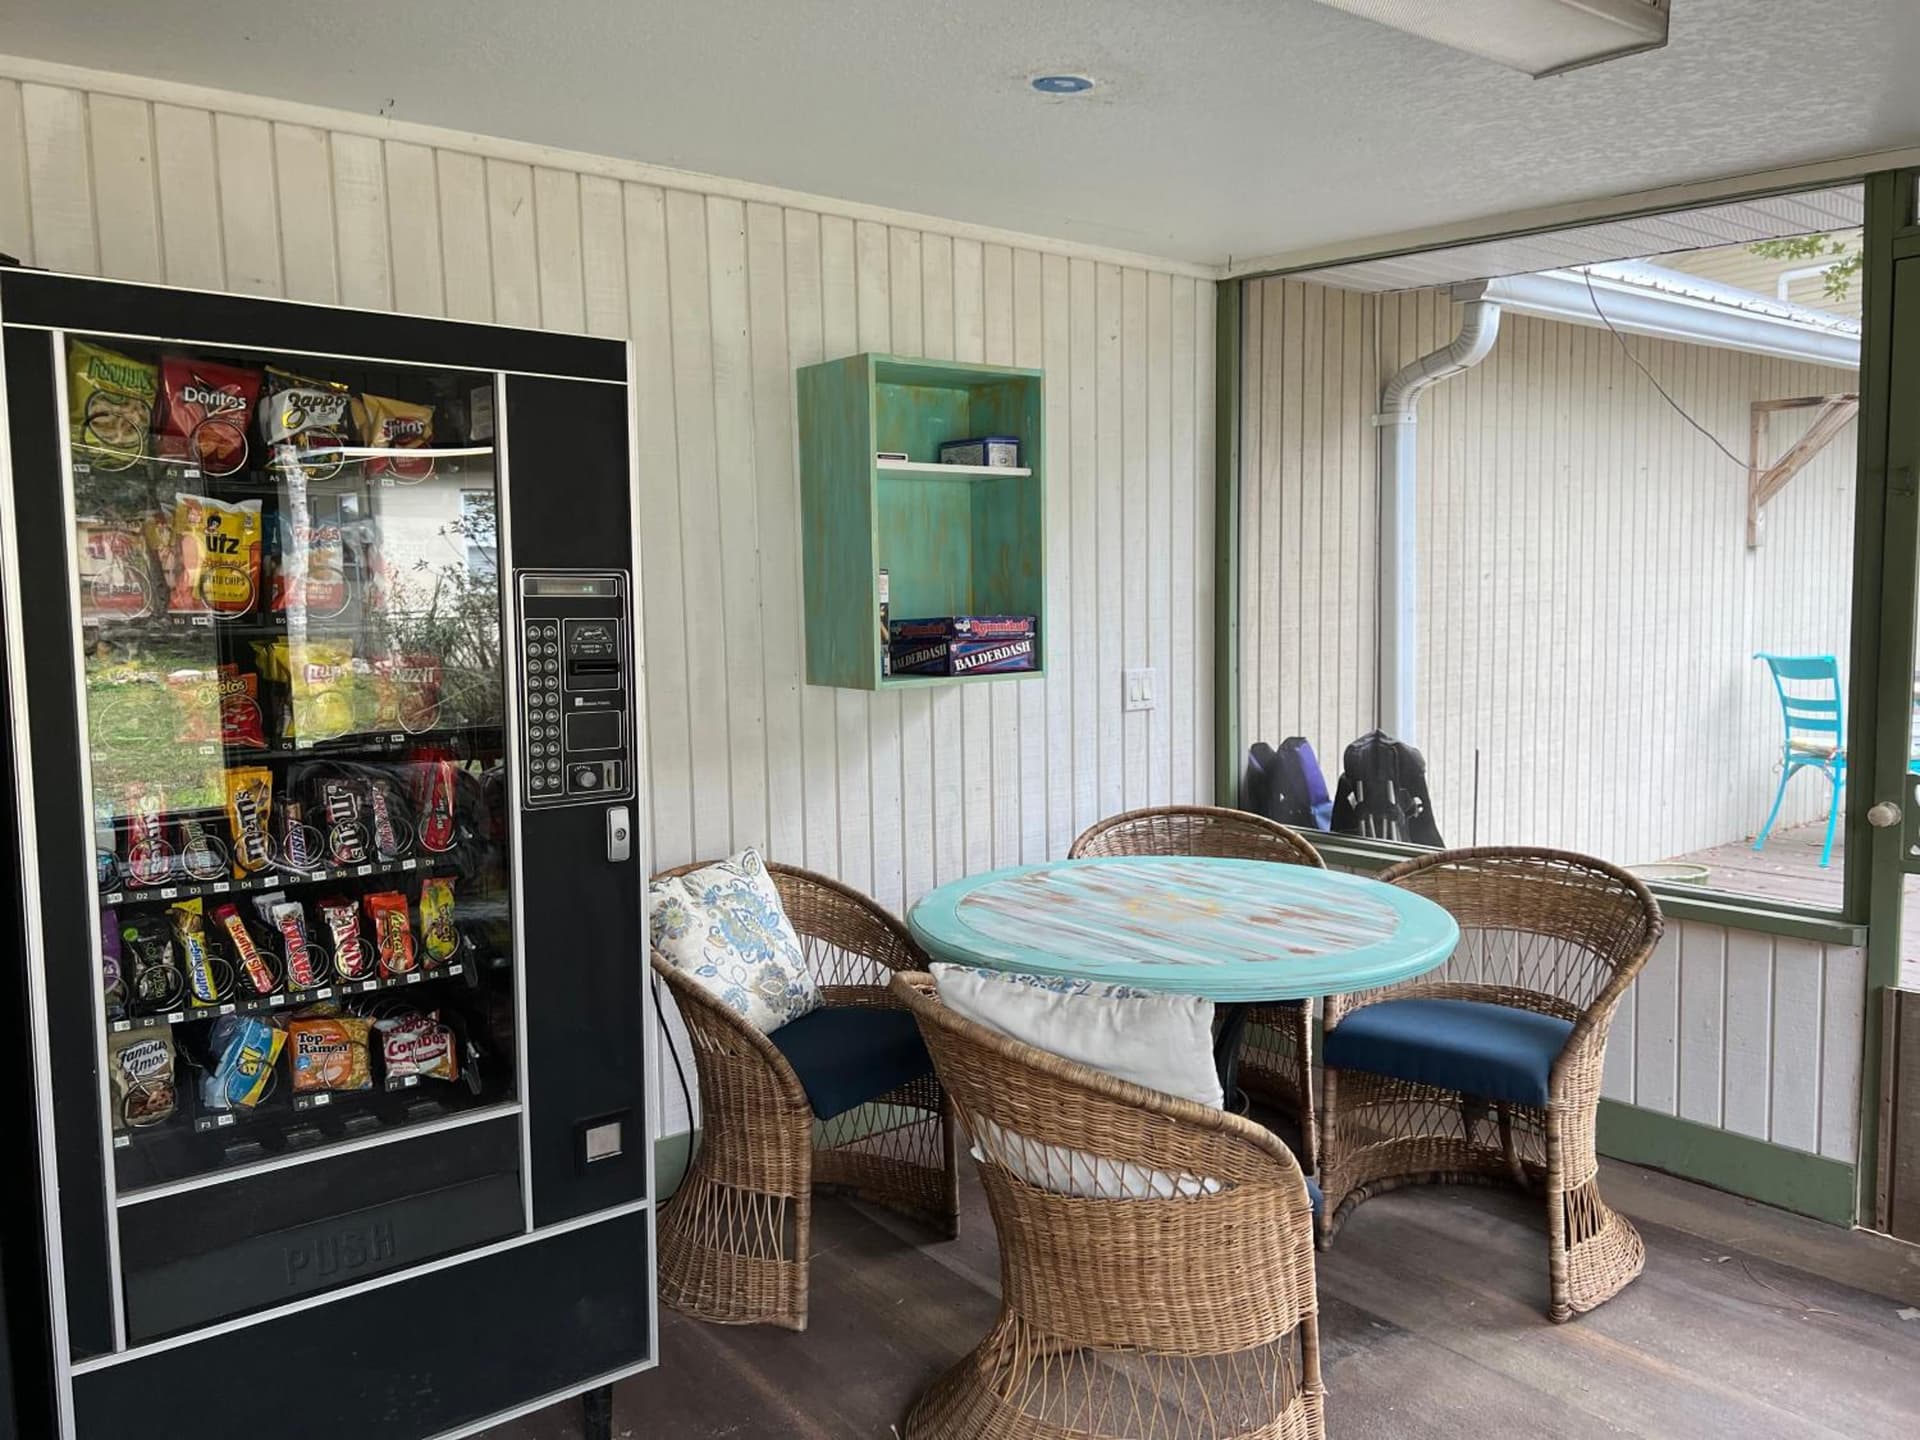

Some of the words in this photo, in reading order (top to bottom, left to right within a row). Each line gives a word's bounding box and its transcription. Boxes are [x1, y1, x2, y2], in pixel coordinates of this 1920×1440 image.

[184, 386, 248, 409] Doritos
[383, 417, 425, 441] Fritos
[954, 640, 1031, 671] BALDERDASH
[297, 1032, 324, 1046] Top
[299, 1043, 349, 1054] Ramen
[130, 1053, 165, 1074] Amos
[283, 1220, 396, 1286] PUSH
